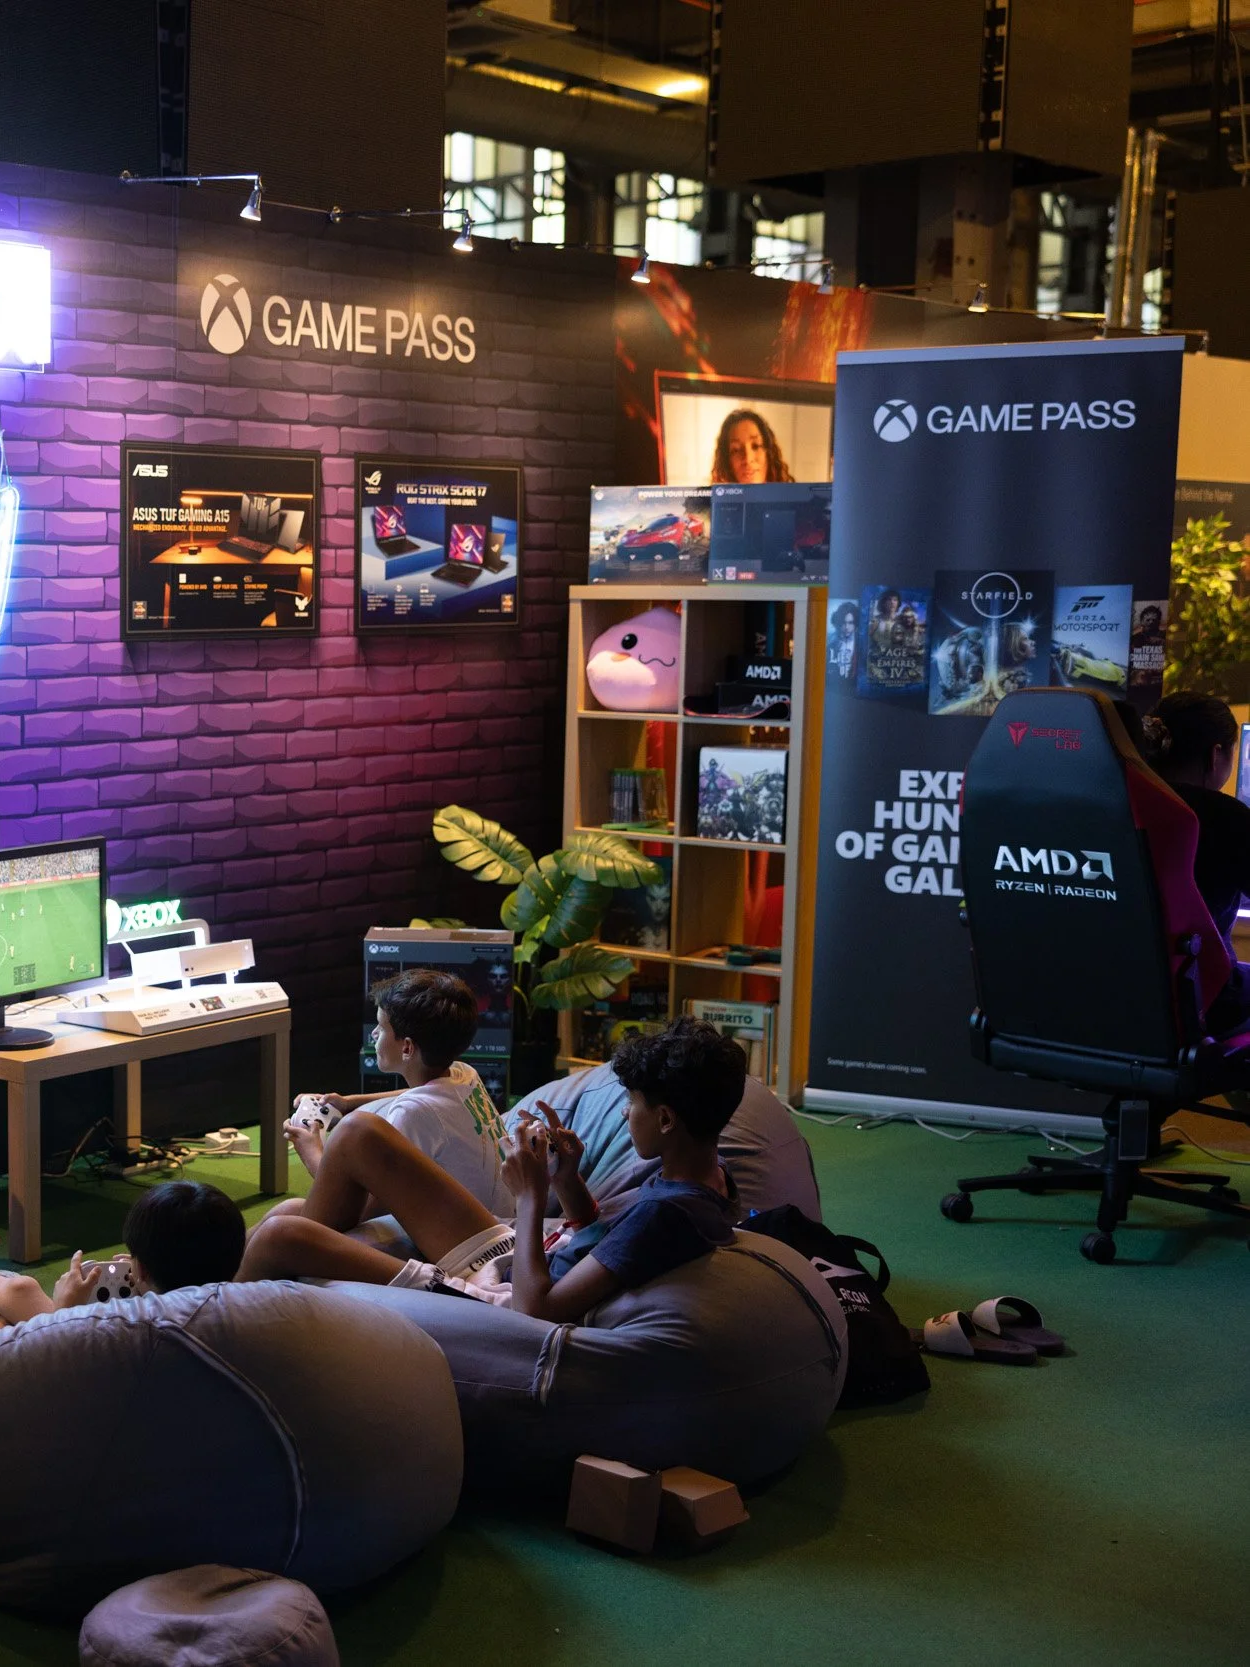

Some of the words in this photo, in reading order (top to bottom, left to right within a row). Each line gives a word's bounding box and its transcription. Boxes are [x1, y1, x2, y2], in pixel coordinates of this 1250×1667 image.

[262, 295, 377, 354] GAME
[385, 309, 476, 364] PASS
[926, 403, 1034, 434] GAME
[1041, 400, 1136, 431] PASS
[132, 464, 168, 477] ASUS
[396, 483, 418, 495] ROG
[419, 484, 449, 496] STRIX
[450, 485, 477, 497] SCAR
[478, 486, 488, 497] 17
[132, 507, 158, 521] ASUS
[159, 507, 178, 522] TUF
[178, 508, 213, 523] GAMING
[214, 509, 230, 523] A15
[961, 591, 1034, 601] STARFIELD
[1053, 623, 1121, 633] MOTORSPORT
[885, 647, 908, 657] AGE
[745, 664, 771, 679] AMD
[877, 659, 917, 668] EMPIRES
[890, 667, 904, 679] IV
[899, 769, 965, 800] EXP
[874, 800, 960, 833] HUN
[835, 830, 886, 860] OF
[993, 845, 1078, 876] AMD
[884, 864, 965, 898] GAL
[995, 879, 1045, 894] RYZEN
[1053, 885, 1117, 901] RADEON
[121, 899, 182, 932] XBOX
[379, 945, 400, 953] XBOX
[702, 1012, 754, 1024] BURRITO
[827, 1056, 844, 1067] Some
[845, 1060, 865, 1069] games
[866, 1060, 886, 1070] shown
[887, 1062, 910, 1074] coming
[910, 1065, 927, 1074] soon.
